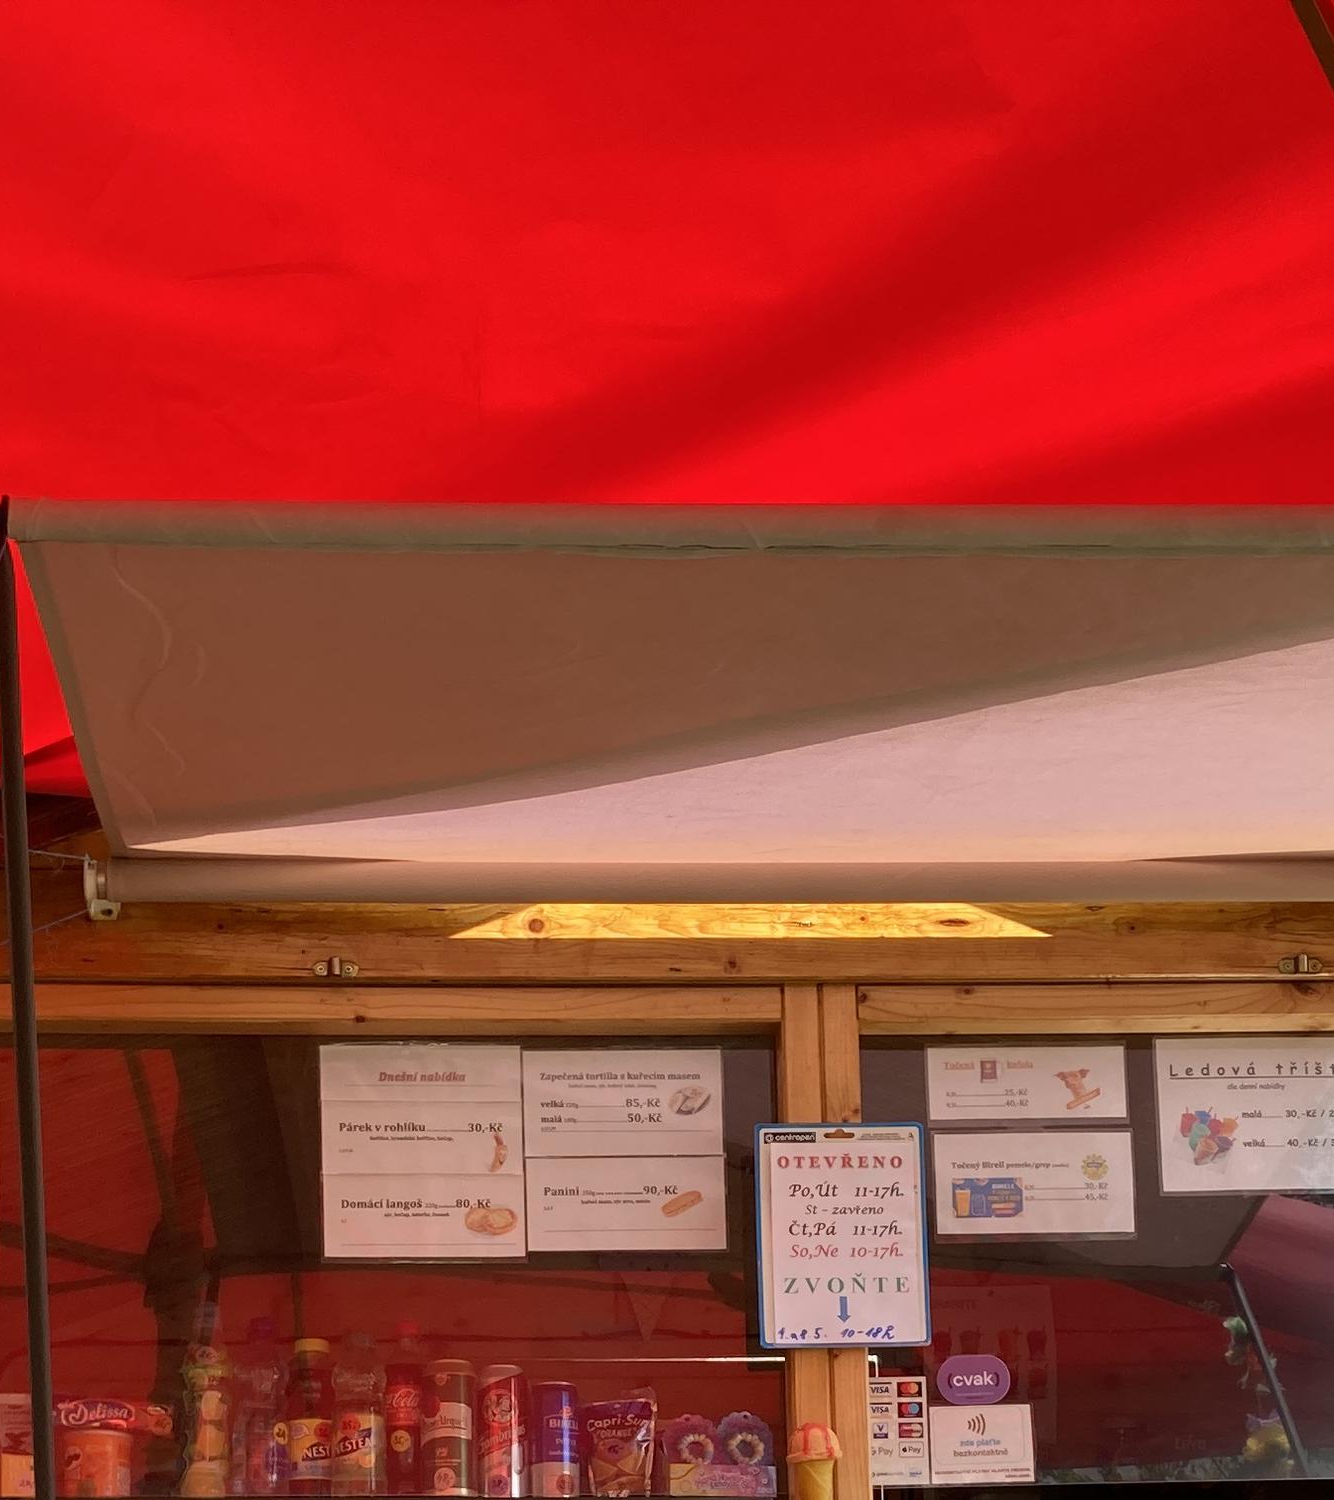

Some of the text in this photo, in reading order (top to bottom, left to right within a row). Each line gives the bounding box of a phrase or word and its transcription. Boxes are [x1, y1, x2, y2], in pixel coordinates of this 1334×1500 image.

[1169, 1062, 1256, 1076] Ledová
[379, 1072, 466, 1082] Dnešní nabídka
[540, 1072, 584, 1081] Zapečená
[586, 1072, 618, 1080] tortilla
[627, 1072, 665, 1080] kuřecím
[541, 1115, 562, 1123] malá
[339, 1122, 503, 1134] Párek v rohlíku 30,-Kč
[774, 1133, 815, 1142] centropen
[1243, 1139, 1265, 1148] velká
[777, 1153, 903, 1169] OTEVŘENO
[544, 1186, 579, 1196] Panini
[789, 1180, 839, 1198] Po,Út
[341, 1199, 382, 1209] Domácí
[386, 1198, 422, 1210] langoš
[804, 1204, 817, 1215] St
[832, 1204, 884, 1215] zavřeno
[788, 1220, 837, 1237] Čt,Pá
[790, 1244, 838, 1259] So,Ne
[784, 1273, 910, 1294] ZVOŇTE
[871, 1386, 889, 1394] VISA
[69, 1403, 129, 1425] Delissa
[871, 1406, 889, 1414] VISA
[878, 1447, 893, 1458] Pay
[908, 1446, 921, 1454] Pay
